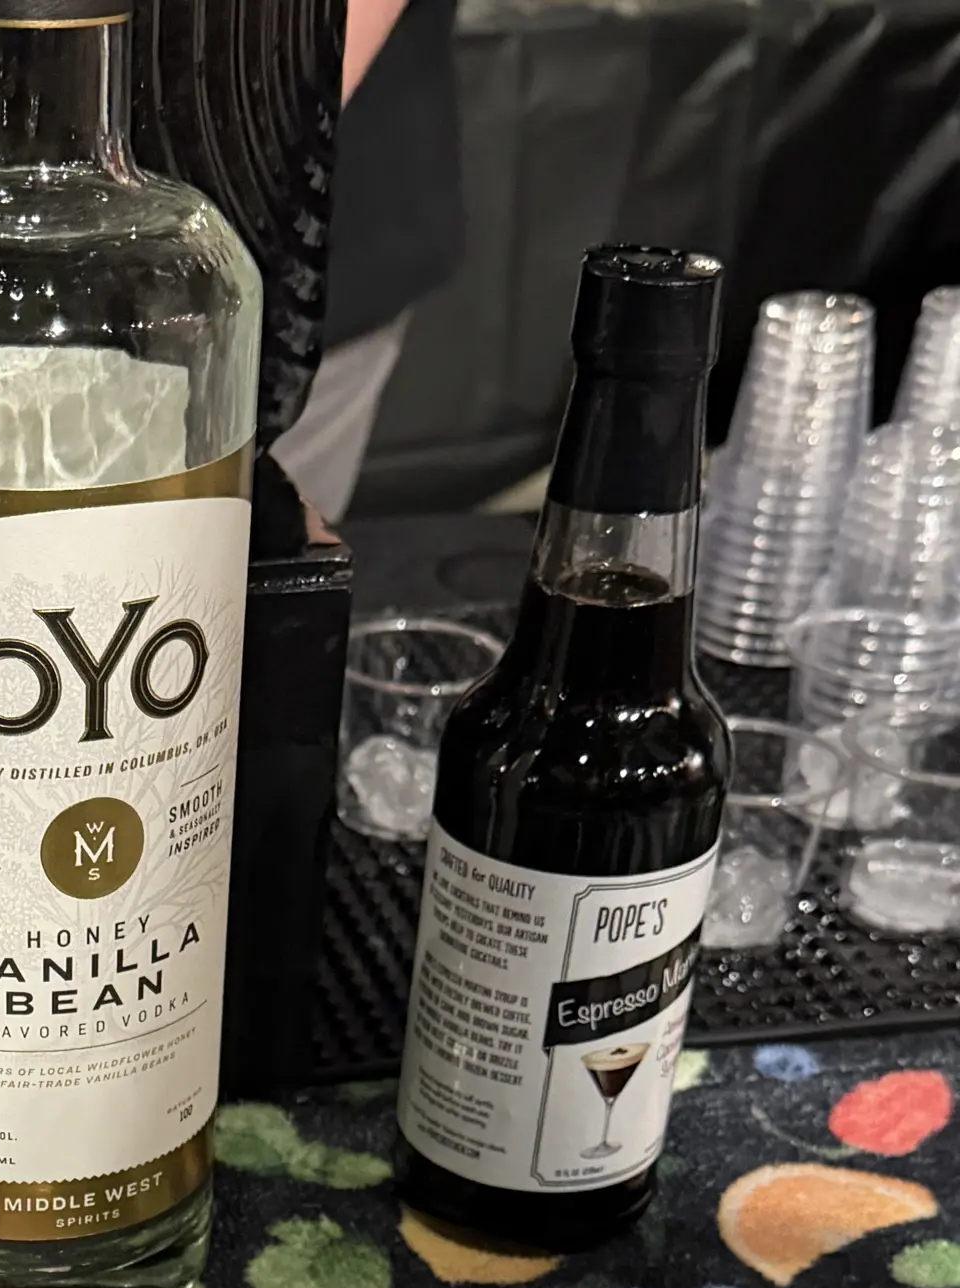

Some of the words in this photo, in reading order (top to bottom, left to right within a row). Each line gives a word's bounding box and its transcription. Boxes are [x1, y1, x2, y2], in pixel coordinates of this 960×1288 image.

[10, 765, 92, 780] DISTILLED
[98, 762, 115, 775] IN
[120, 741, 192, 773] COLUMBUS,
[214, 717, 228, 738] USA
[169, 779, 223, 824] SMOOTH
[168, 818, 221, 857] INSPIRED
[169, 829, 176, 840] &
[179, 803, 221, 836] SEASONALLY
[471, 867, 486, 882] for
[488, 873, 536, 901] QUALITY
[26, 913, 152, 949] HONEY
[514, 928, 549, 944] ARTISAN
[594, 898, 668, 943] POPE'S
[5, 970, 164, 1016] BEAN
[122, 991, 190, 1028] VODKA
[558, 983, 659, 1031] Espresso
[0, 1078, 81, 1089] FAIR-TRADE
[86, 1066, 138, 1085] VANILLA
[141, 1051, 176, 1072] BEANS
[18, 1067, 35, 1077] OF
[40, 1065, 82, 1077] LOCAL
[87, 1044, 164, 1072] WILDFLOWER
[166, 1026, 197, 1050] HONEY
[3, 1191, 96, 1213] MIDDLE
[104, 1171, 165, 1203] WEST
[55, 1208, 122, 1229] SPIRITS
